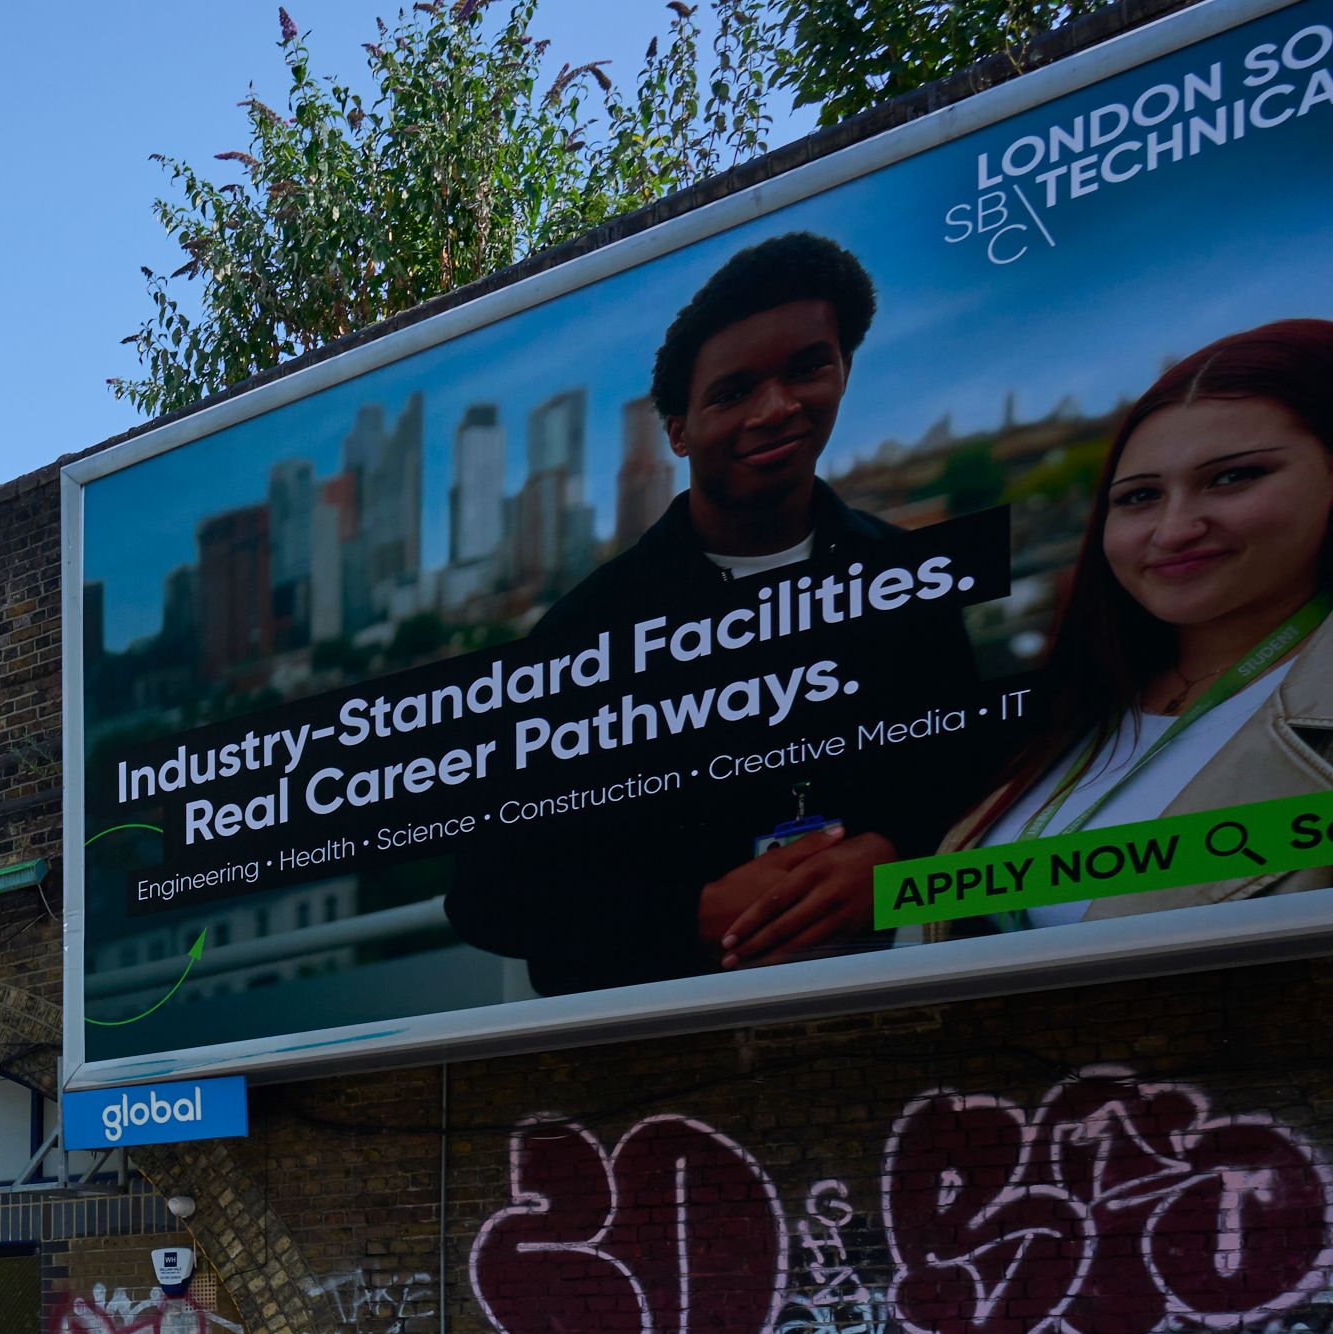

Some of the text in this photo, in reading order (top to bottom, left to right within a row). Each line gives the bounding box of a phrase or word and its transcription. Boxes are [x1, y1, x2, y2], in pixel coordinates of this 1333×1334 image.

[978, 62, 1221, 190] LONDON
[116, 554, 975, 804] Industry-Standard Facilities.
[1237, 626, 1300, 677] STUDENT
[137, 688, 1032, 902] Engineering Health Science Construction Creative Media IT
[184, 658, 859, 846] Real Career Pathways.
[892, 834, 1180, 912] APPLY NOW
[1289, 813, 1333, 850] S
[101, 1085, 203, 1144] global
